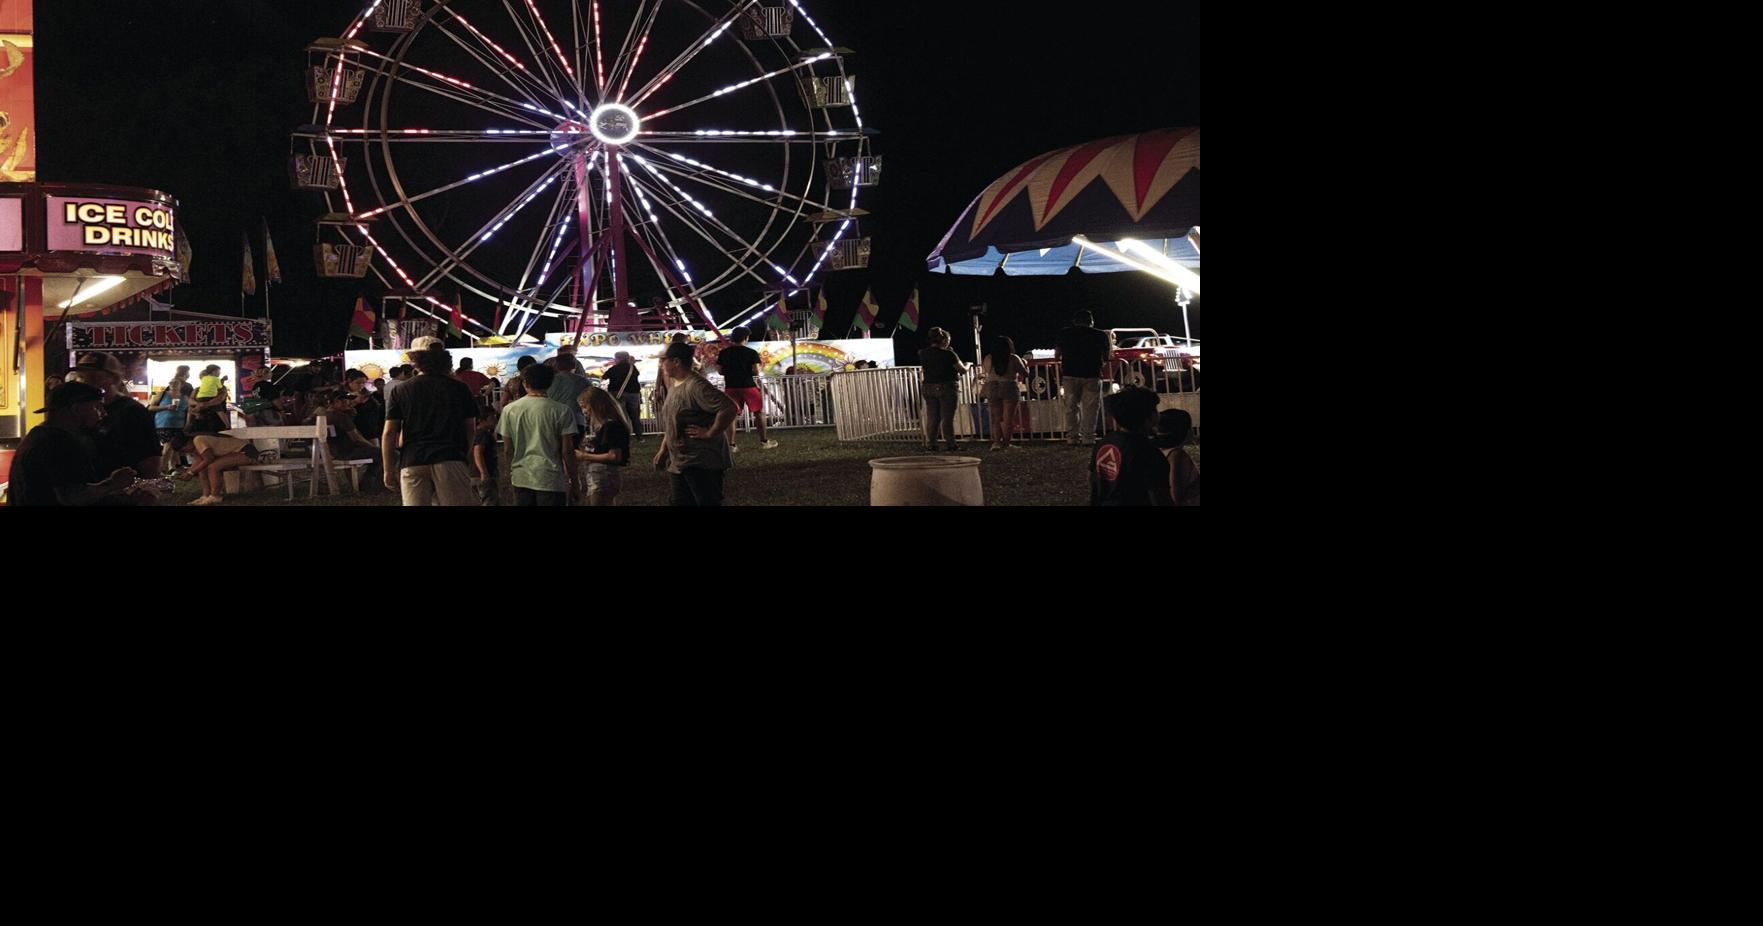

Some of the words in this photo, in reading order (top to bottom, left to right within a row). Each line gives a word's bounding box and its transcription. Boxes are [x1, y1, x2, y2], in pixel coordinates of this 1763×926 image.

[65, 202, 127, 224] ICE
[134, 207, 174, 231] COL
[84, 225, 174, 251] DRINKS
[86, 322, 254, 346] TICKETS
[629, 331, 703, 345] WHEL
